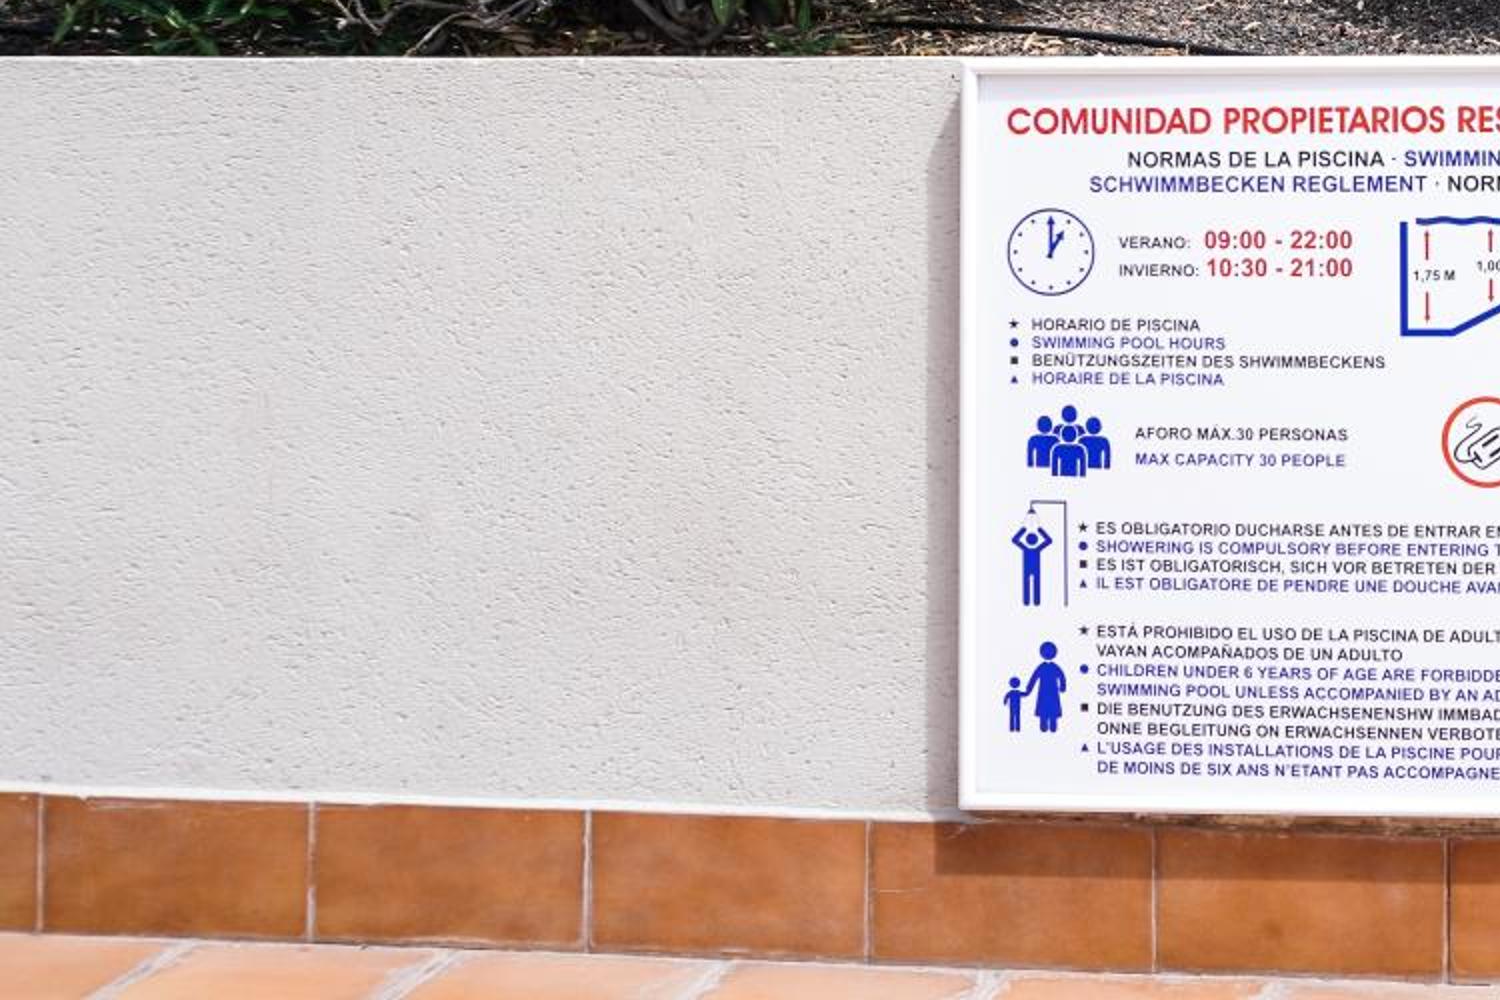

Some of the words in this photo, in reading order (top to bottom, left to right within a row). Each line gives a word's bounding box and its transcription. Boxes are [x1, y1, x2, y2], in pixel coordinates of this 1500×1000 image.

[1006, 106, 1212, 135] COMUNIDAD
[1223, 105, 1445, 134] PROPIETARIOS
[1127, 151, 1221, 168] NORMAS
[1228, 151, 1256, 168] DE
[1264, 151, 1291, 168] LA
[1298, 149, 1384, 167] PISCINA
[1089, 175, 1284, 192] SCHWIMMBECKEN
[1292, 175, 1427, 192] REGLEMENT
[1118, 235, 1190, 249] VERANO:
[1204, 229, 1266, 249] 09:00
[1290, 229, 1352, 249] 22:00
[1119, 263, 1198, 277] INVIERNO:
[1207, 257, 1267, 277] 10:30
[1289, 257, 1352, 277] 21:00
[1413, 269, 1440, 282] 1,75
[1443, 269, 1455, 280] M
[1031, 317, 1105, 331] HORARIO
[1110, 318, 1131, 331] DE
[1137, 318, 1200, 332] PISCINA
[1031, 335, 1114, 348] SWIMMING
[1120, 336, 1164, 349] POOL
[1169, 337, 1225, 350] HOURS
[1032, 352, 1196, 368] BENÜTZUNGSZEITEN
[1201, 355, 1234, 368] DES
[1239, 355, 1385, 368] SHWIMMBECKENS
[1032, 371, 1103, 384] HORAIRE
[1109, 371, 1130, 384] DE
[1135, 373, 1155, 384] LA
[1160, 372, 1224, 386] PISCINA
[1135, 426, 1192, 440] AFORO
[1259, 427, 1348, 441] PERSONAS
[1135, 452, 1169, 465] MAX
[1174, 453, 1254, 466] CAPACITY
[1259, 453, 1276, 466] 30
[1281, 453, 1344, 467] PEOPLE
[1095, 521, 1116, 534] ES
[1121, 521, 1230, 536] OBLIGATORIO
[1235, 523, 1324, 536] DUCHARSE
[1328, 523, 1382, 537] ANTES
[1387, 524, 1408, 538] DE
[1414, 524, 1480, 538] ENTRAR
[1095, 539, 1194, 554] SHOWERING
[1199, 541, 1213, 554] IS
[1217, 541, 1330, 555] COMPULSORY
[1335, 542, 1401, 556] BEFORE
[1407, 543, 1488, 556] ENTERING
[1096, 644, 1146, 657] VAYAN
[1151, 644, 1278, 660] ACOMPAÑADOS
[1283, 647, 1304, 660] DE
[1310, 648, 1332, 660] UN
[1337, 648, 1402, 662] ADULTO
[1097, 682, 1180, 696] SWIMMING
[1185, 684, 1230, 698] POOL
[1235, 685, 1299, 699] UNLESS
[1303, 686, 1424, 701] ACCOMPANIED
[1429, 688, 1451, 701] BY
[1455, 689, 1478, 701] AN
